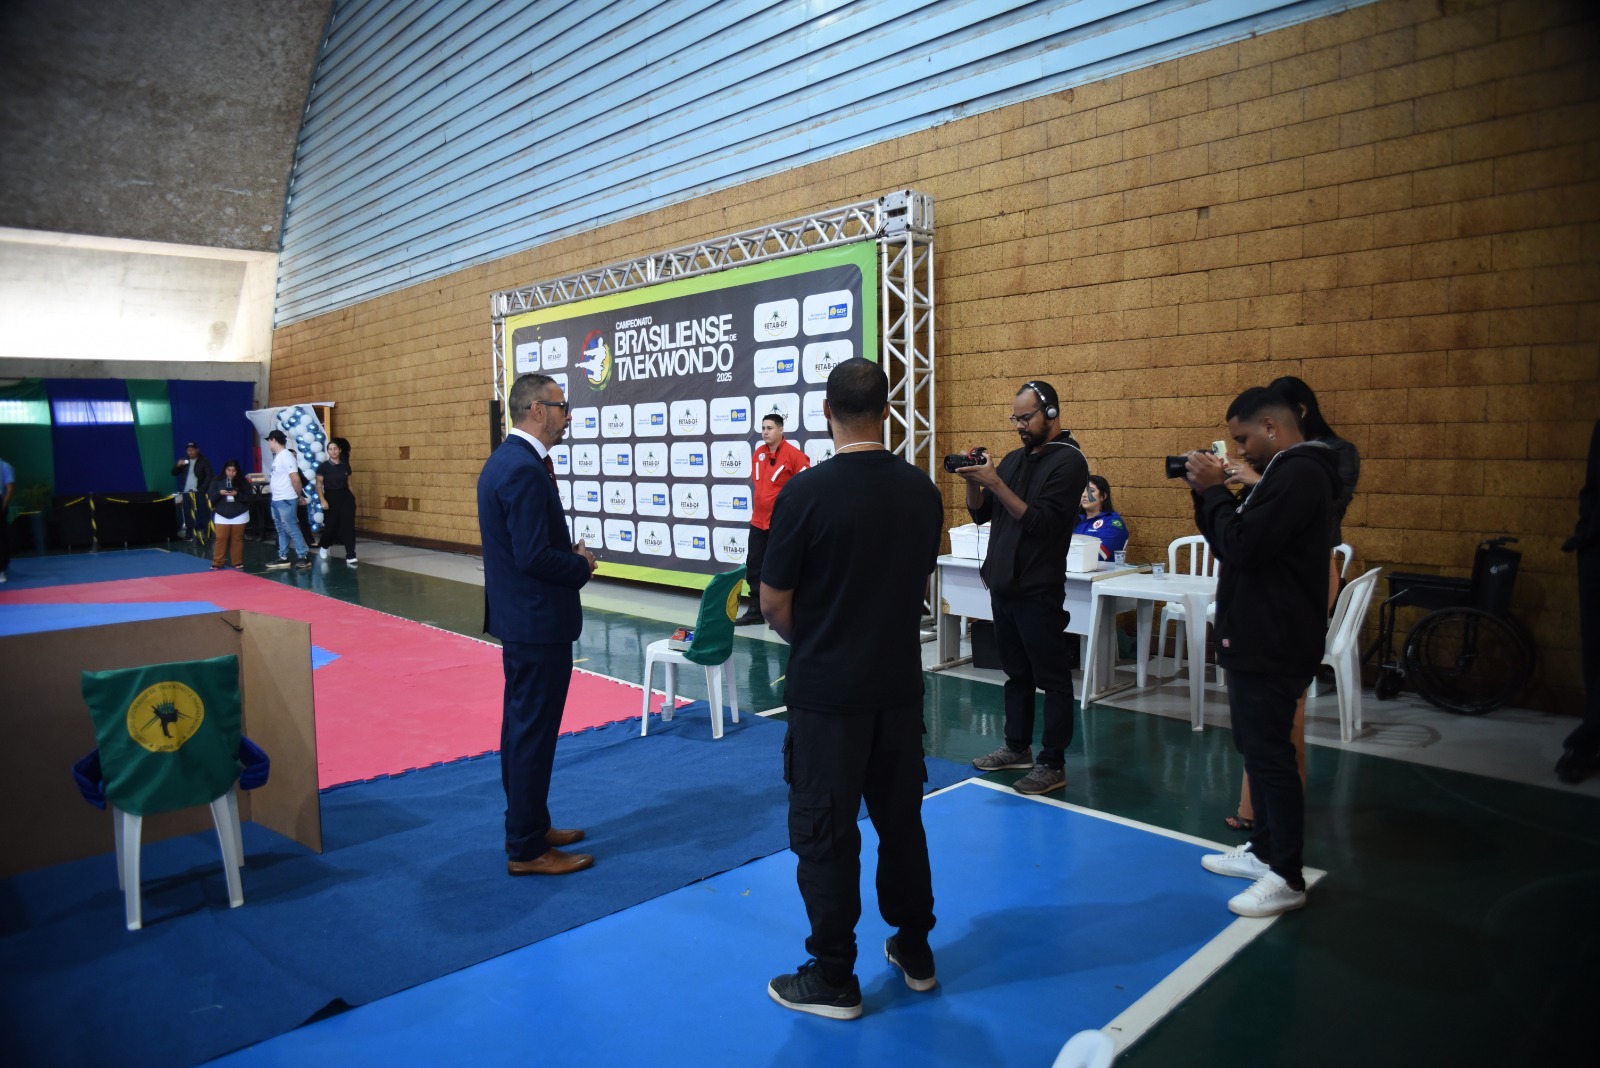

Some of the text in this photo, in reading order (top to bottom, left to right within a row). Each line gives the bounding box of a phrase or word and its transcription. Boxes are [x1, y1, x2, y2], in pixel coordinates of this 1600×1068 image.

[615, 316, 653, 330] CAMPEONATO
[764, 320, 788, 330] FETAB-DF
[614, 313, 737, 356] BRASILIENSE DE
[614, 342, 734, 382] TAEKWONDO
[716, 371, 733, 383] 2025
[723, 545, 746, 554] FETAB-DF
